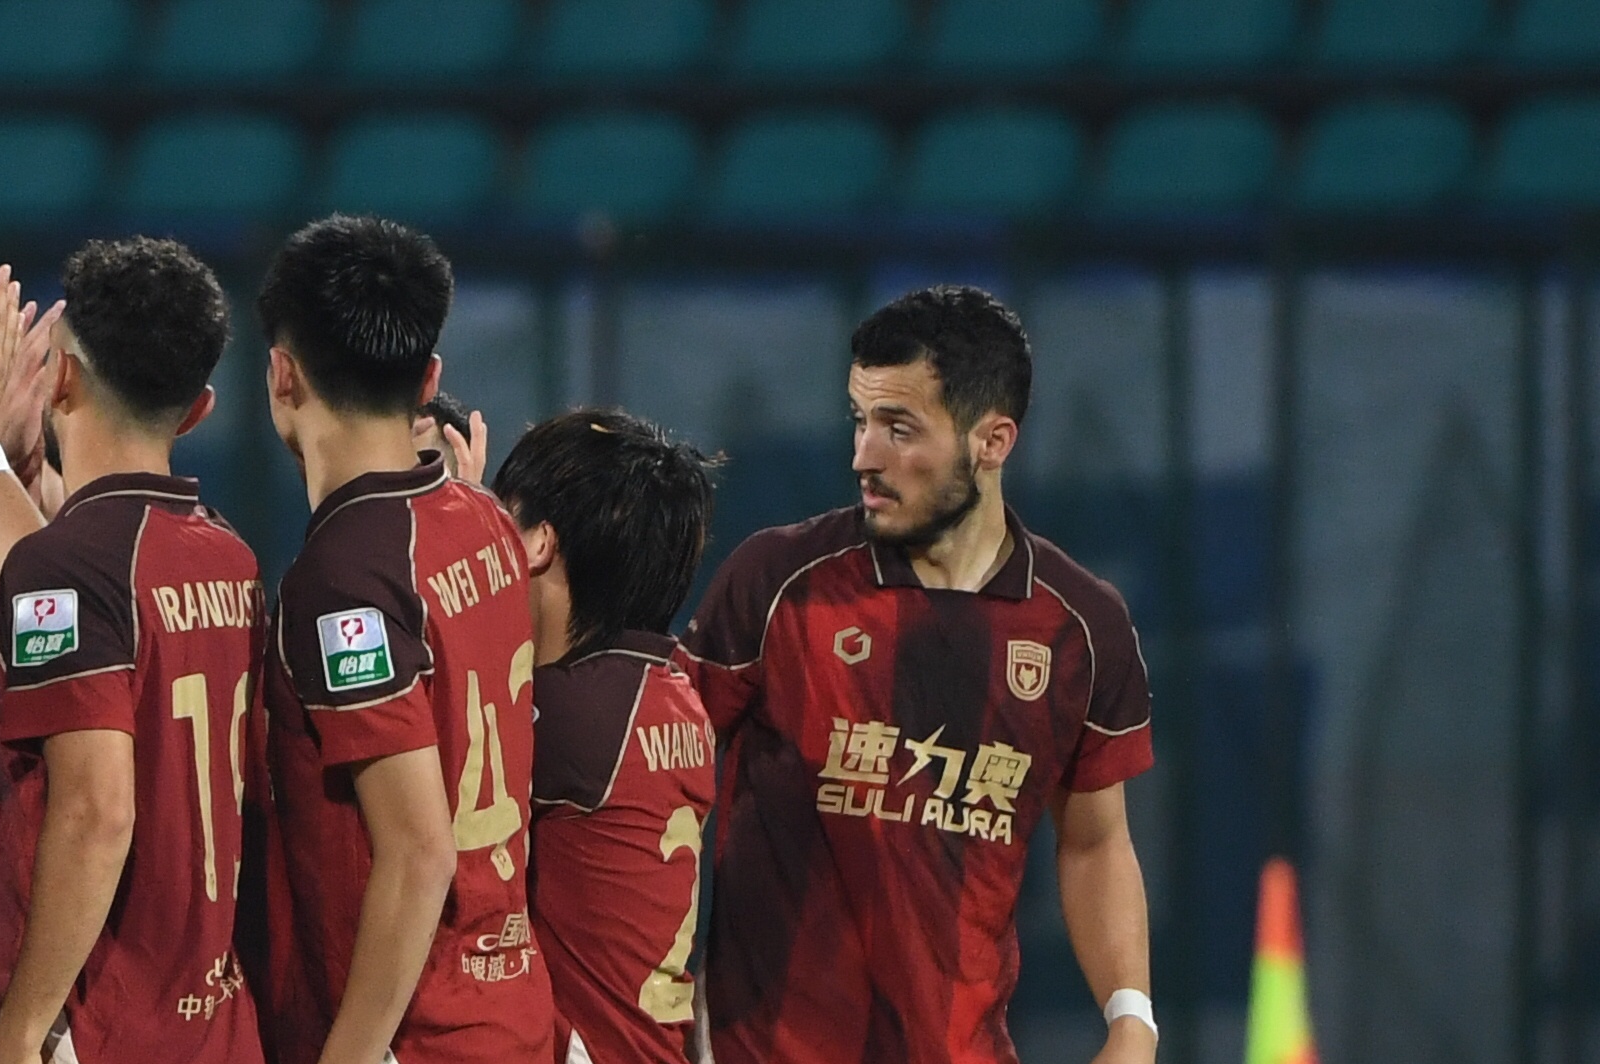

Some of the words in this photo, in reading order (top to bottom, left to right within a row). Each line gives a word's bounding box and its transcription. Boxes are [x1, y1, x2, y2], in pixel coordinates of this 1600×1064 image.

[427, 558, 480, 618] WEI
[636, 722, 705, 772] WANG
[817, 717, 1032, 813] 速力奥
[816, 783, 916, 822] SULI
[920, 797, 1013, 845] AURA
